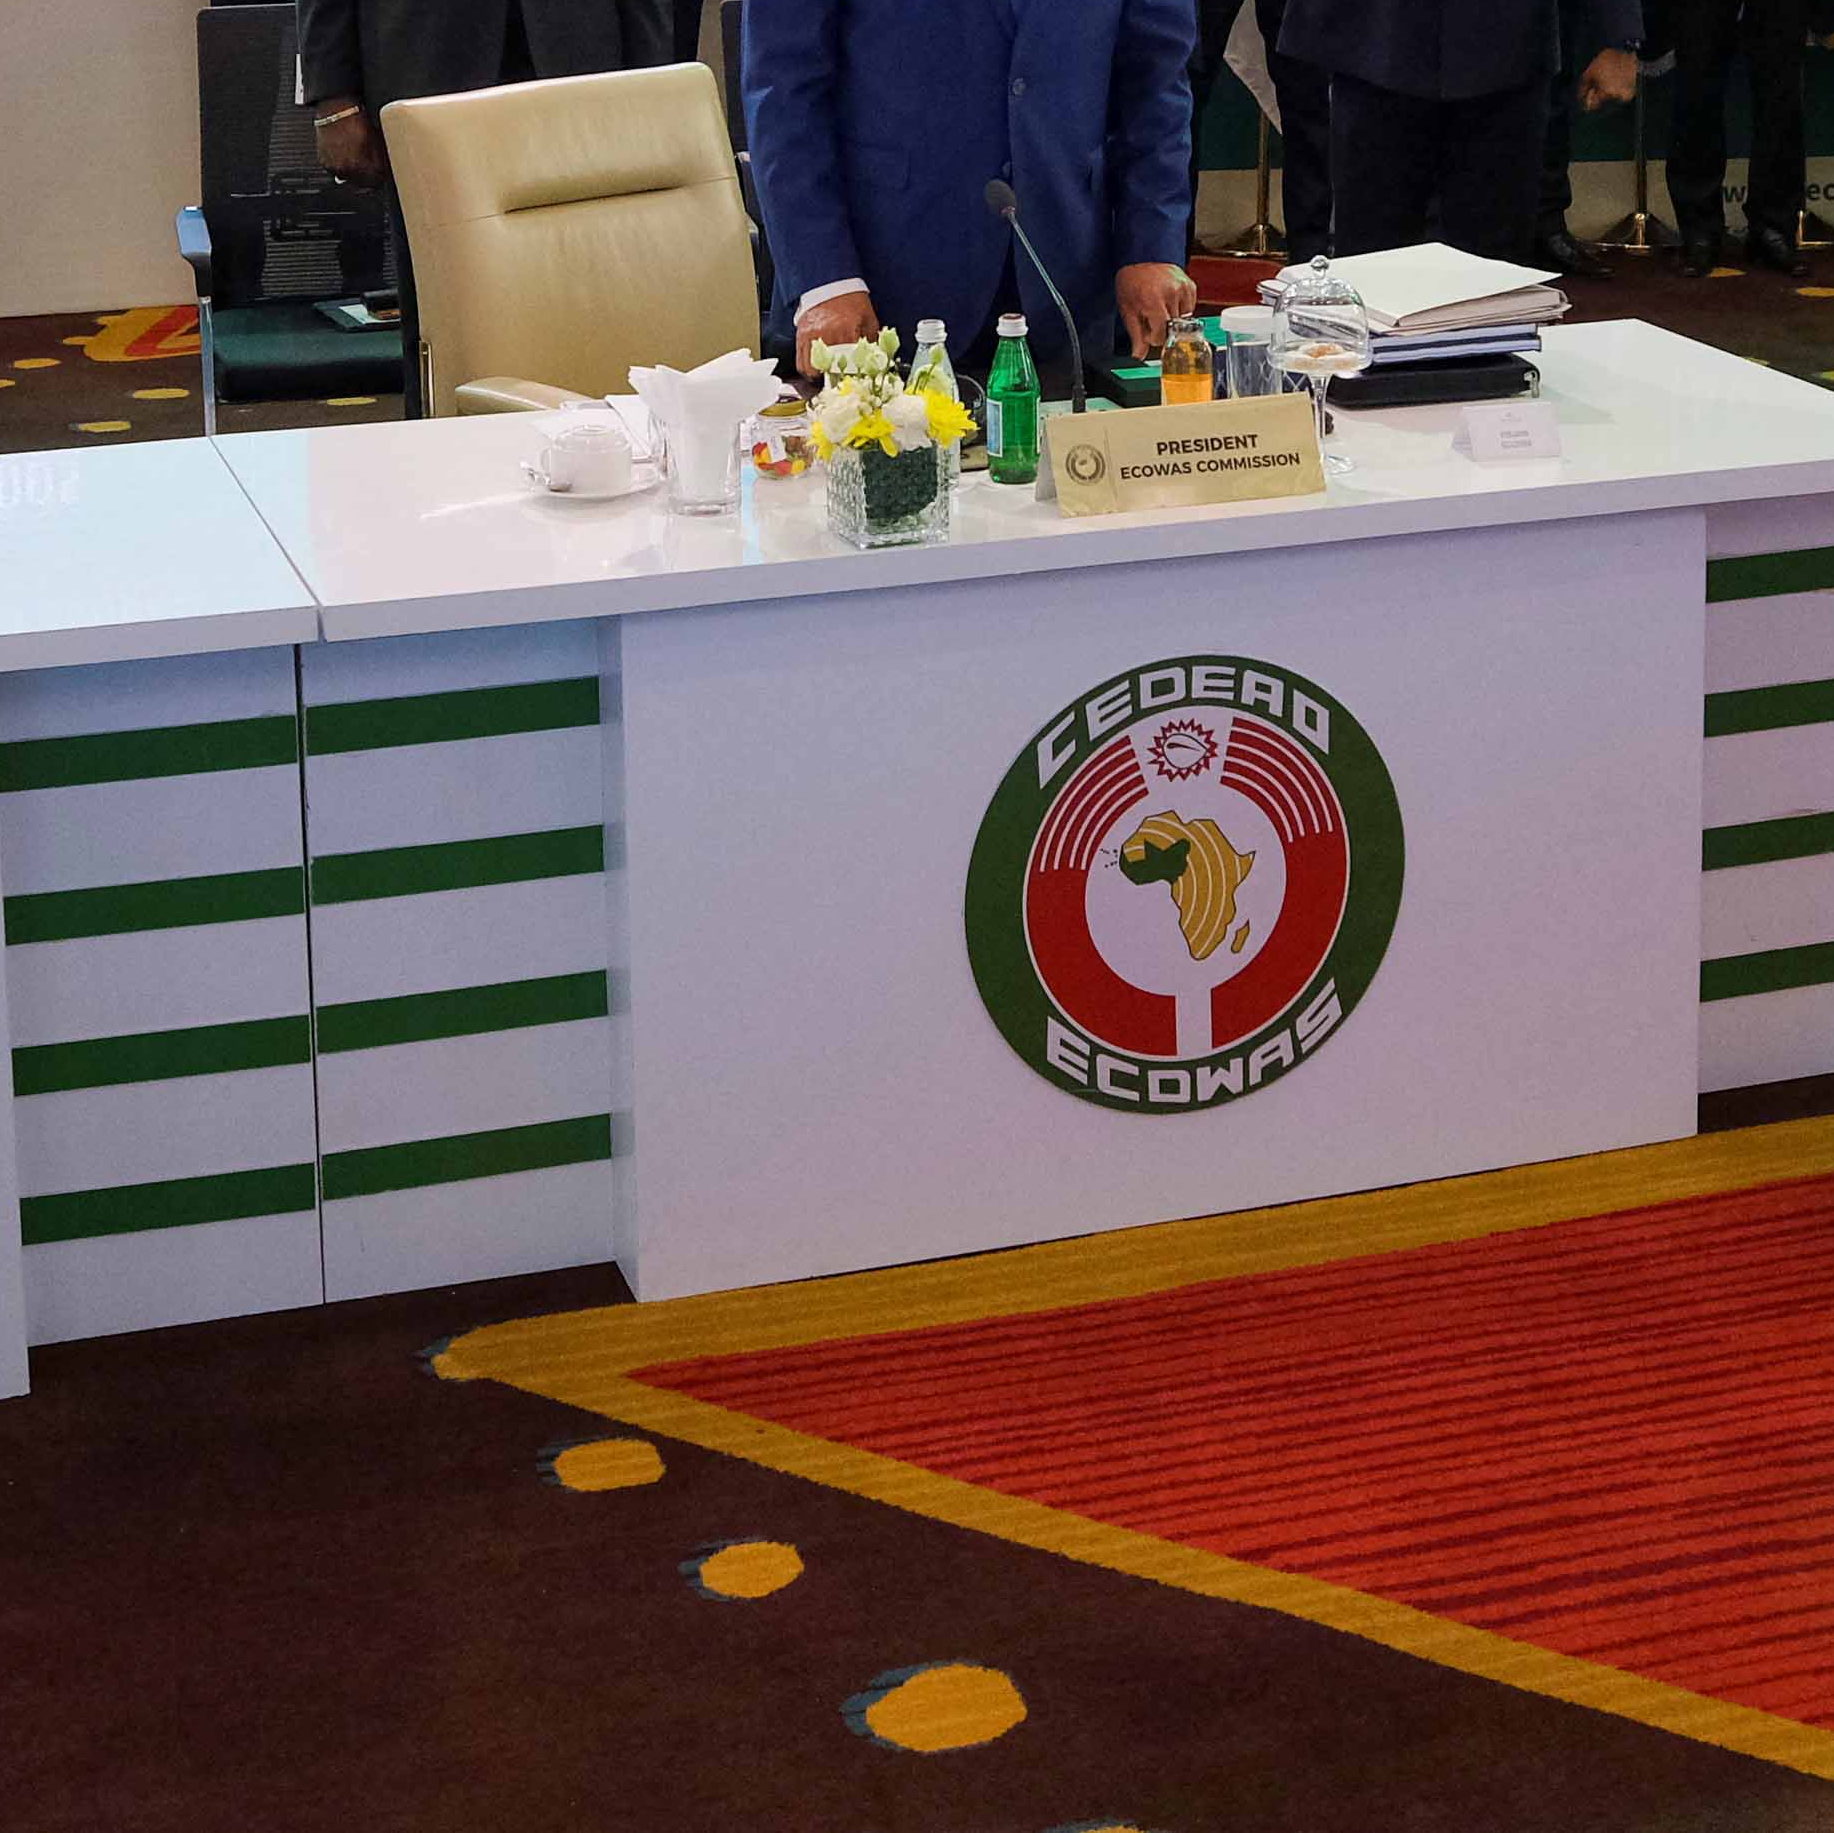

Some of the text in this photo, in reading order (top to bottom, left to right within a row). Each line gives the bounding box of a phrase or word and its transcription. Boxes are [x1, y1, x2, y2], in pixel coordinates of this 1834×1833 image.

[1120, 453, 1301, 479] ECOWAS COMMISSION
[1157, 434, 1259, 455] PRESIDENT
[1037, 665, 1330, 789] CEDEAO
[1047, 977, 1344, 1103] ECOWAS
